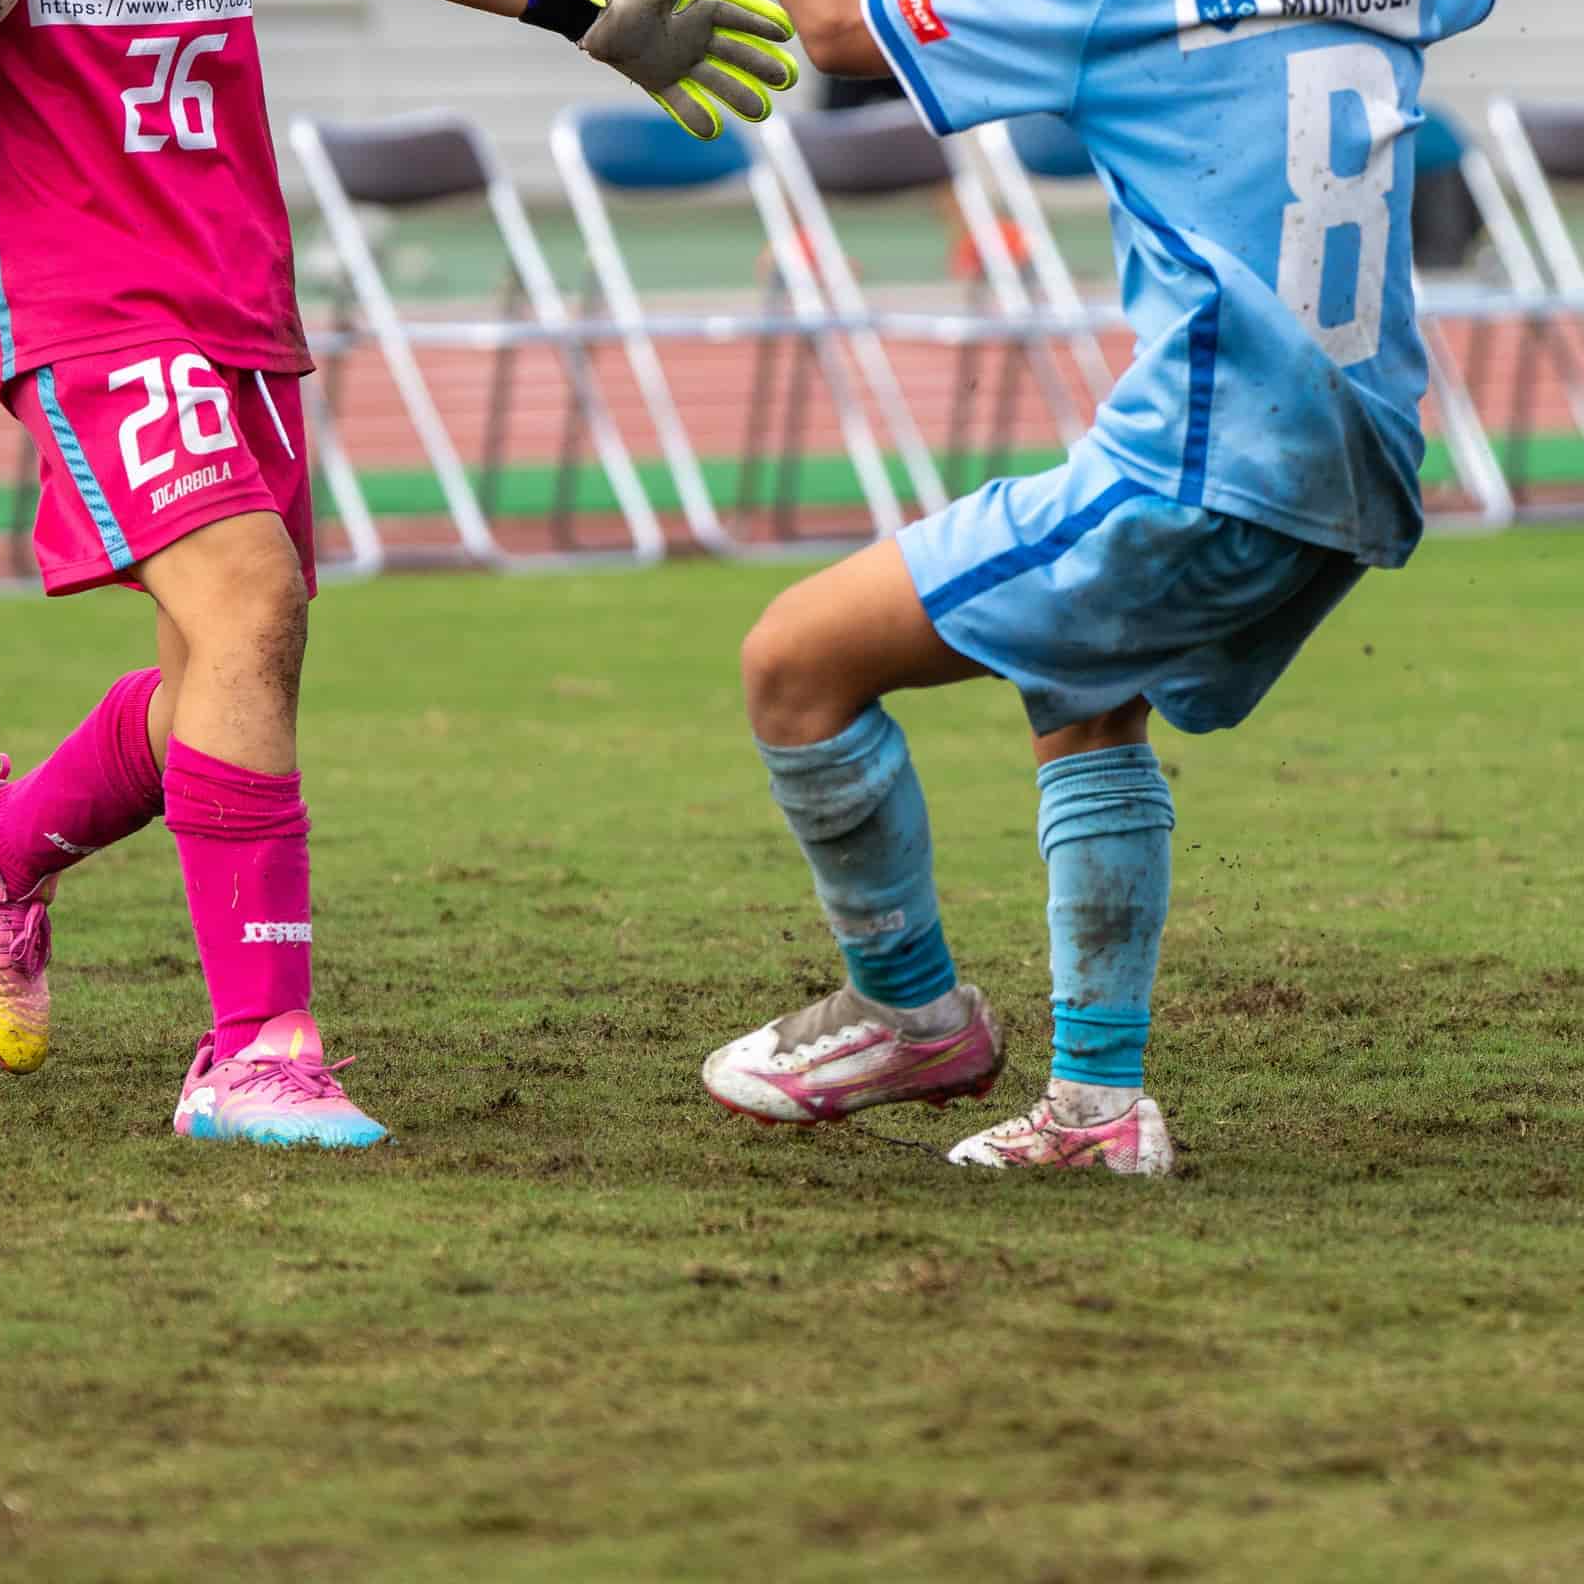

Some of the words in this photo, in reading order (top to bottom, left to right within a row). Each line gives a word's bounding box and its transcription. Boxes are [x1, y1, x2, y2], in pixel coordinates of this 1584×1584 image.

[120, 33, 228, 152] 26
[1278, 43, 1406, 368] 8
[108, 352, 238, 491] 26
[149, 461, 232, 515] JOGARBOLA
